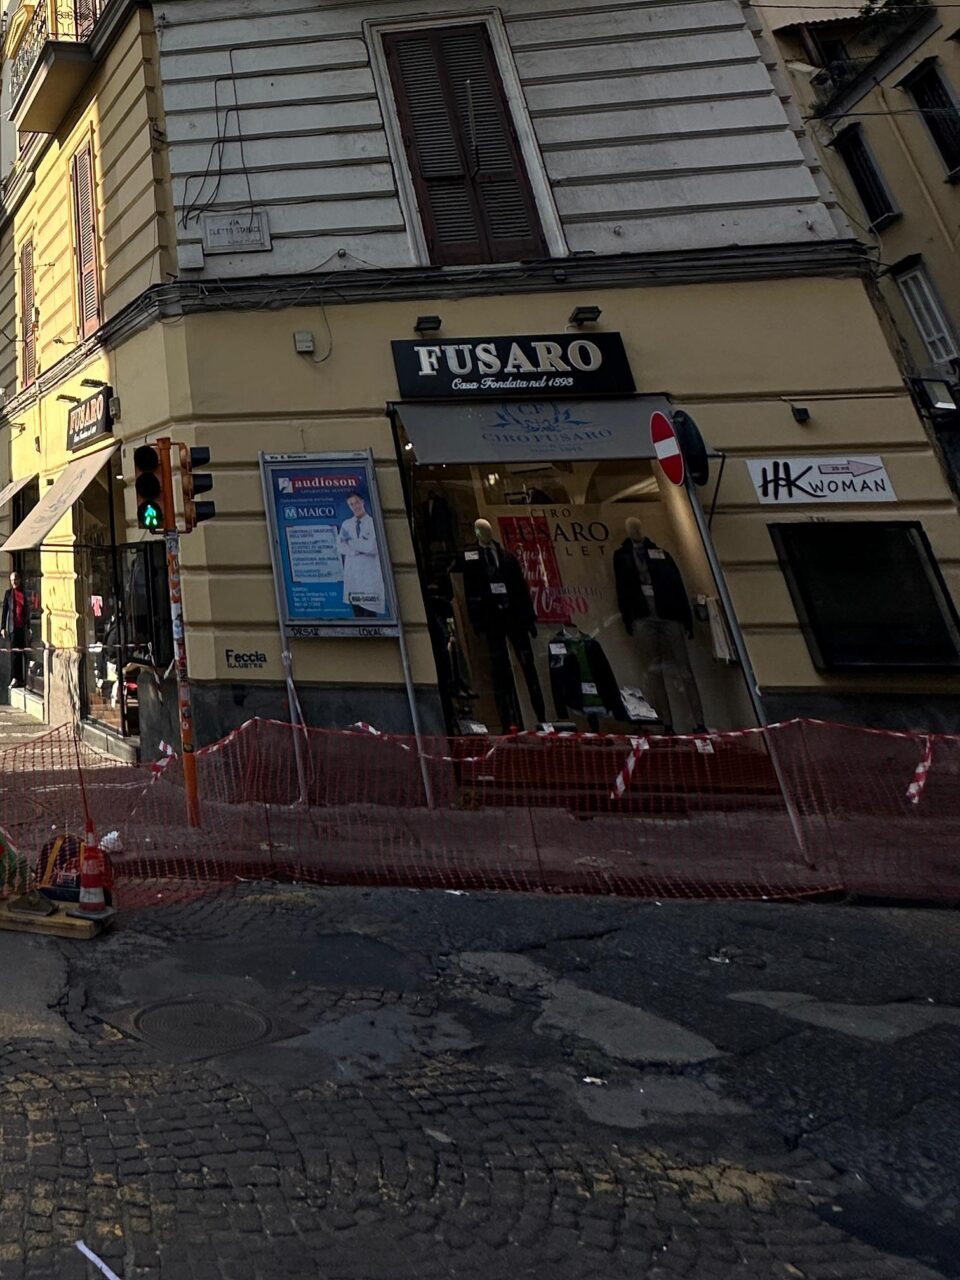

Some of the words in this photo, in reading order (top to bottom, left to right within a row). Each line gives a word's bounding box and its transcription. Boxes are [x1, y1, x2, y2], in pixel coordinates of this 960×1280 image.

[414, 340, 603, 376] FUSARO
[451, 378, 479, 390] Casa
[480, 377, 527, 389] Fondata
[528, 376, 547, 388] nel
[69, 394, 104, 435] FUSARO
[481, 432, 530, 443] CIRO
[532, 428, 613, 443] FUSARO
[295, 477, 357, 488] audioson
[808, 478, 887, 493] WOMAN
[298, 506, 335, 517] MAICO
[530, 508, 571, 518] CIRO
[503, 521, 609, 544] FUSARO
[226, 650, 267, 663] Feccia
